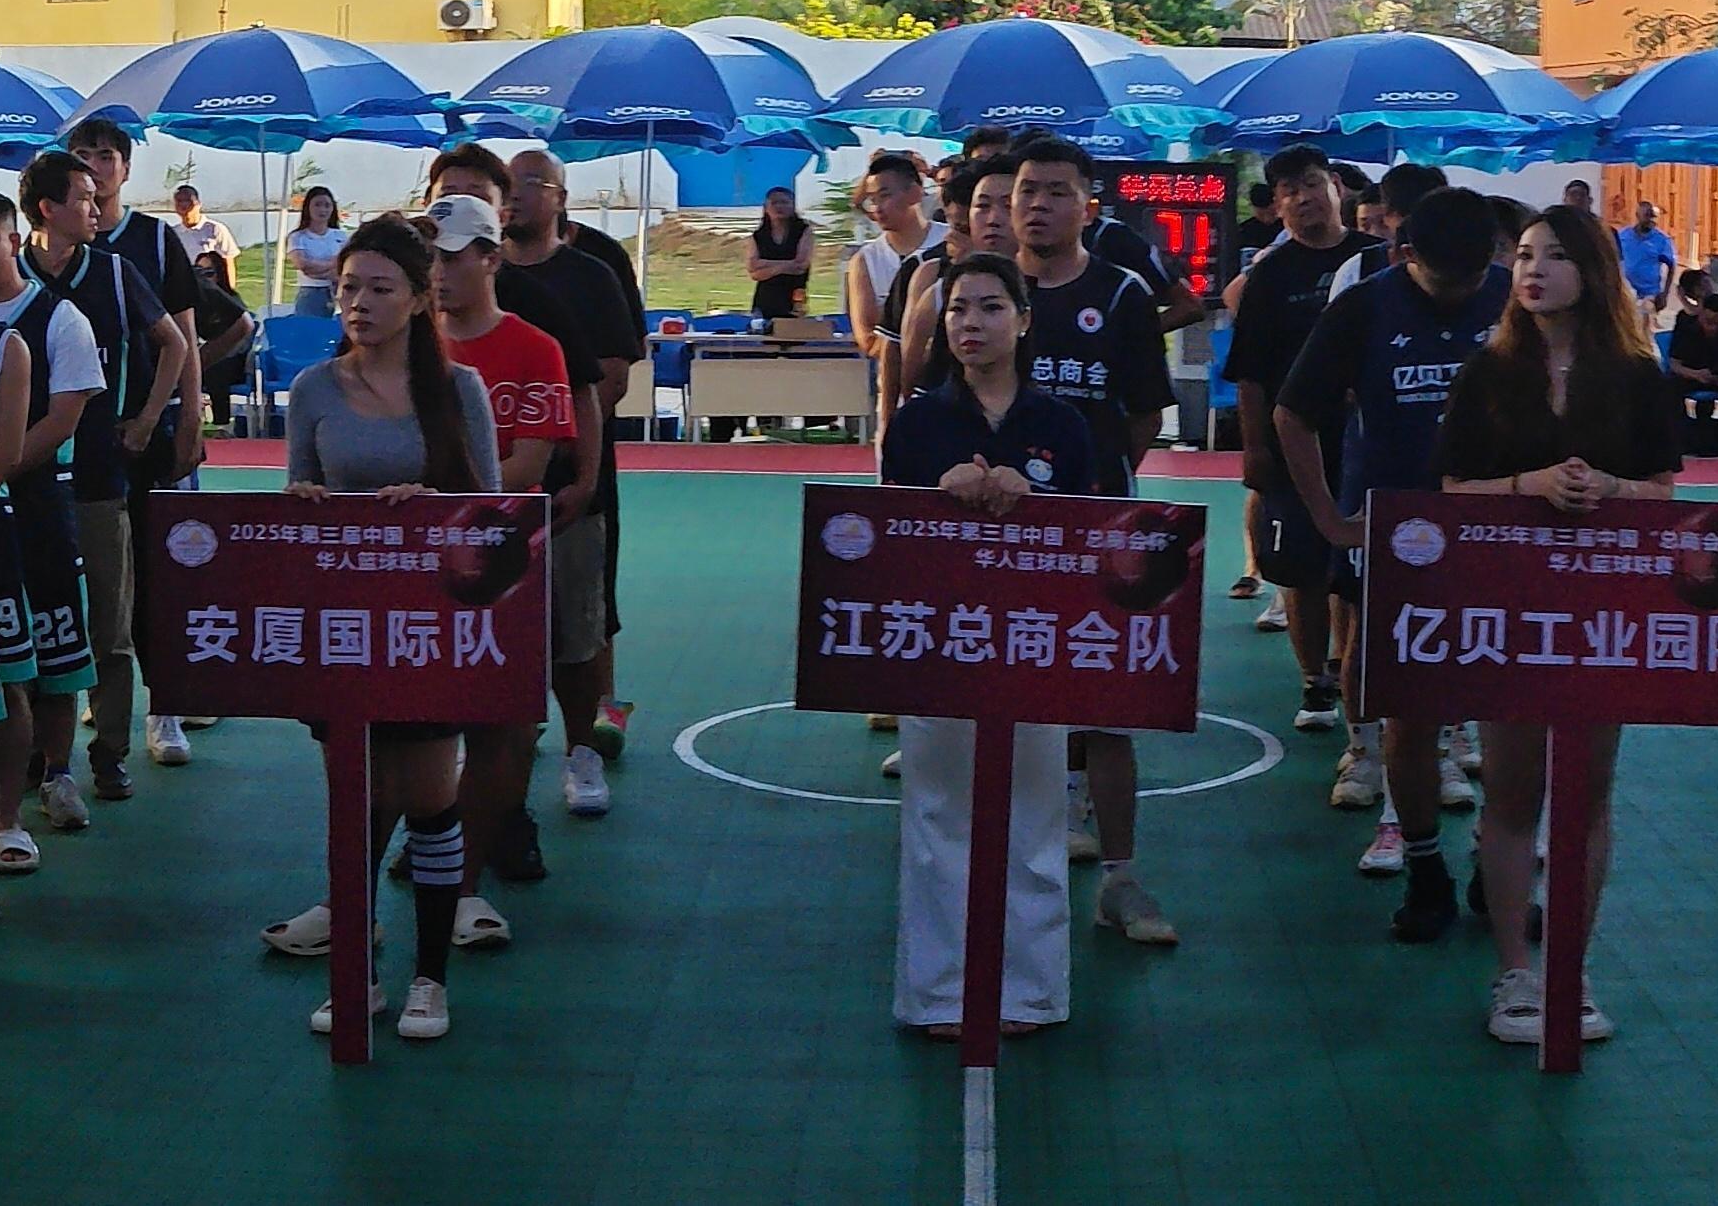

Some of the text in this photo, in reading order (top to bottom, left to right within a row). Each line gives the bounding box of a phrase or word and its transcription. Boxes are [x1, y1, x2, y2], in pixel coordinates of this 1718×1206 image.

[194, 93, 277, 109] JOMOO
[1374, 91, 1460, 102] JOMOO
[606, 106, 692, 117] JOMOO
[981, 106, 1066, 118] JOMOO
[1032, 356, 1109, 386] 总商会
[315, 551, 441, 573] 华人篮球联赛
[975, 547, 1099, 576] 华人篮球联赛
[1547, 552, 1675, 577] 华人篮球联赛
[33, 605, 78, 649] 22
[186, 604, 506, 668] 安厦国际队
[819, 597, 1181, 675] 江苏总商会队
